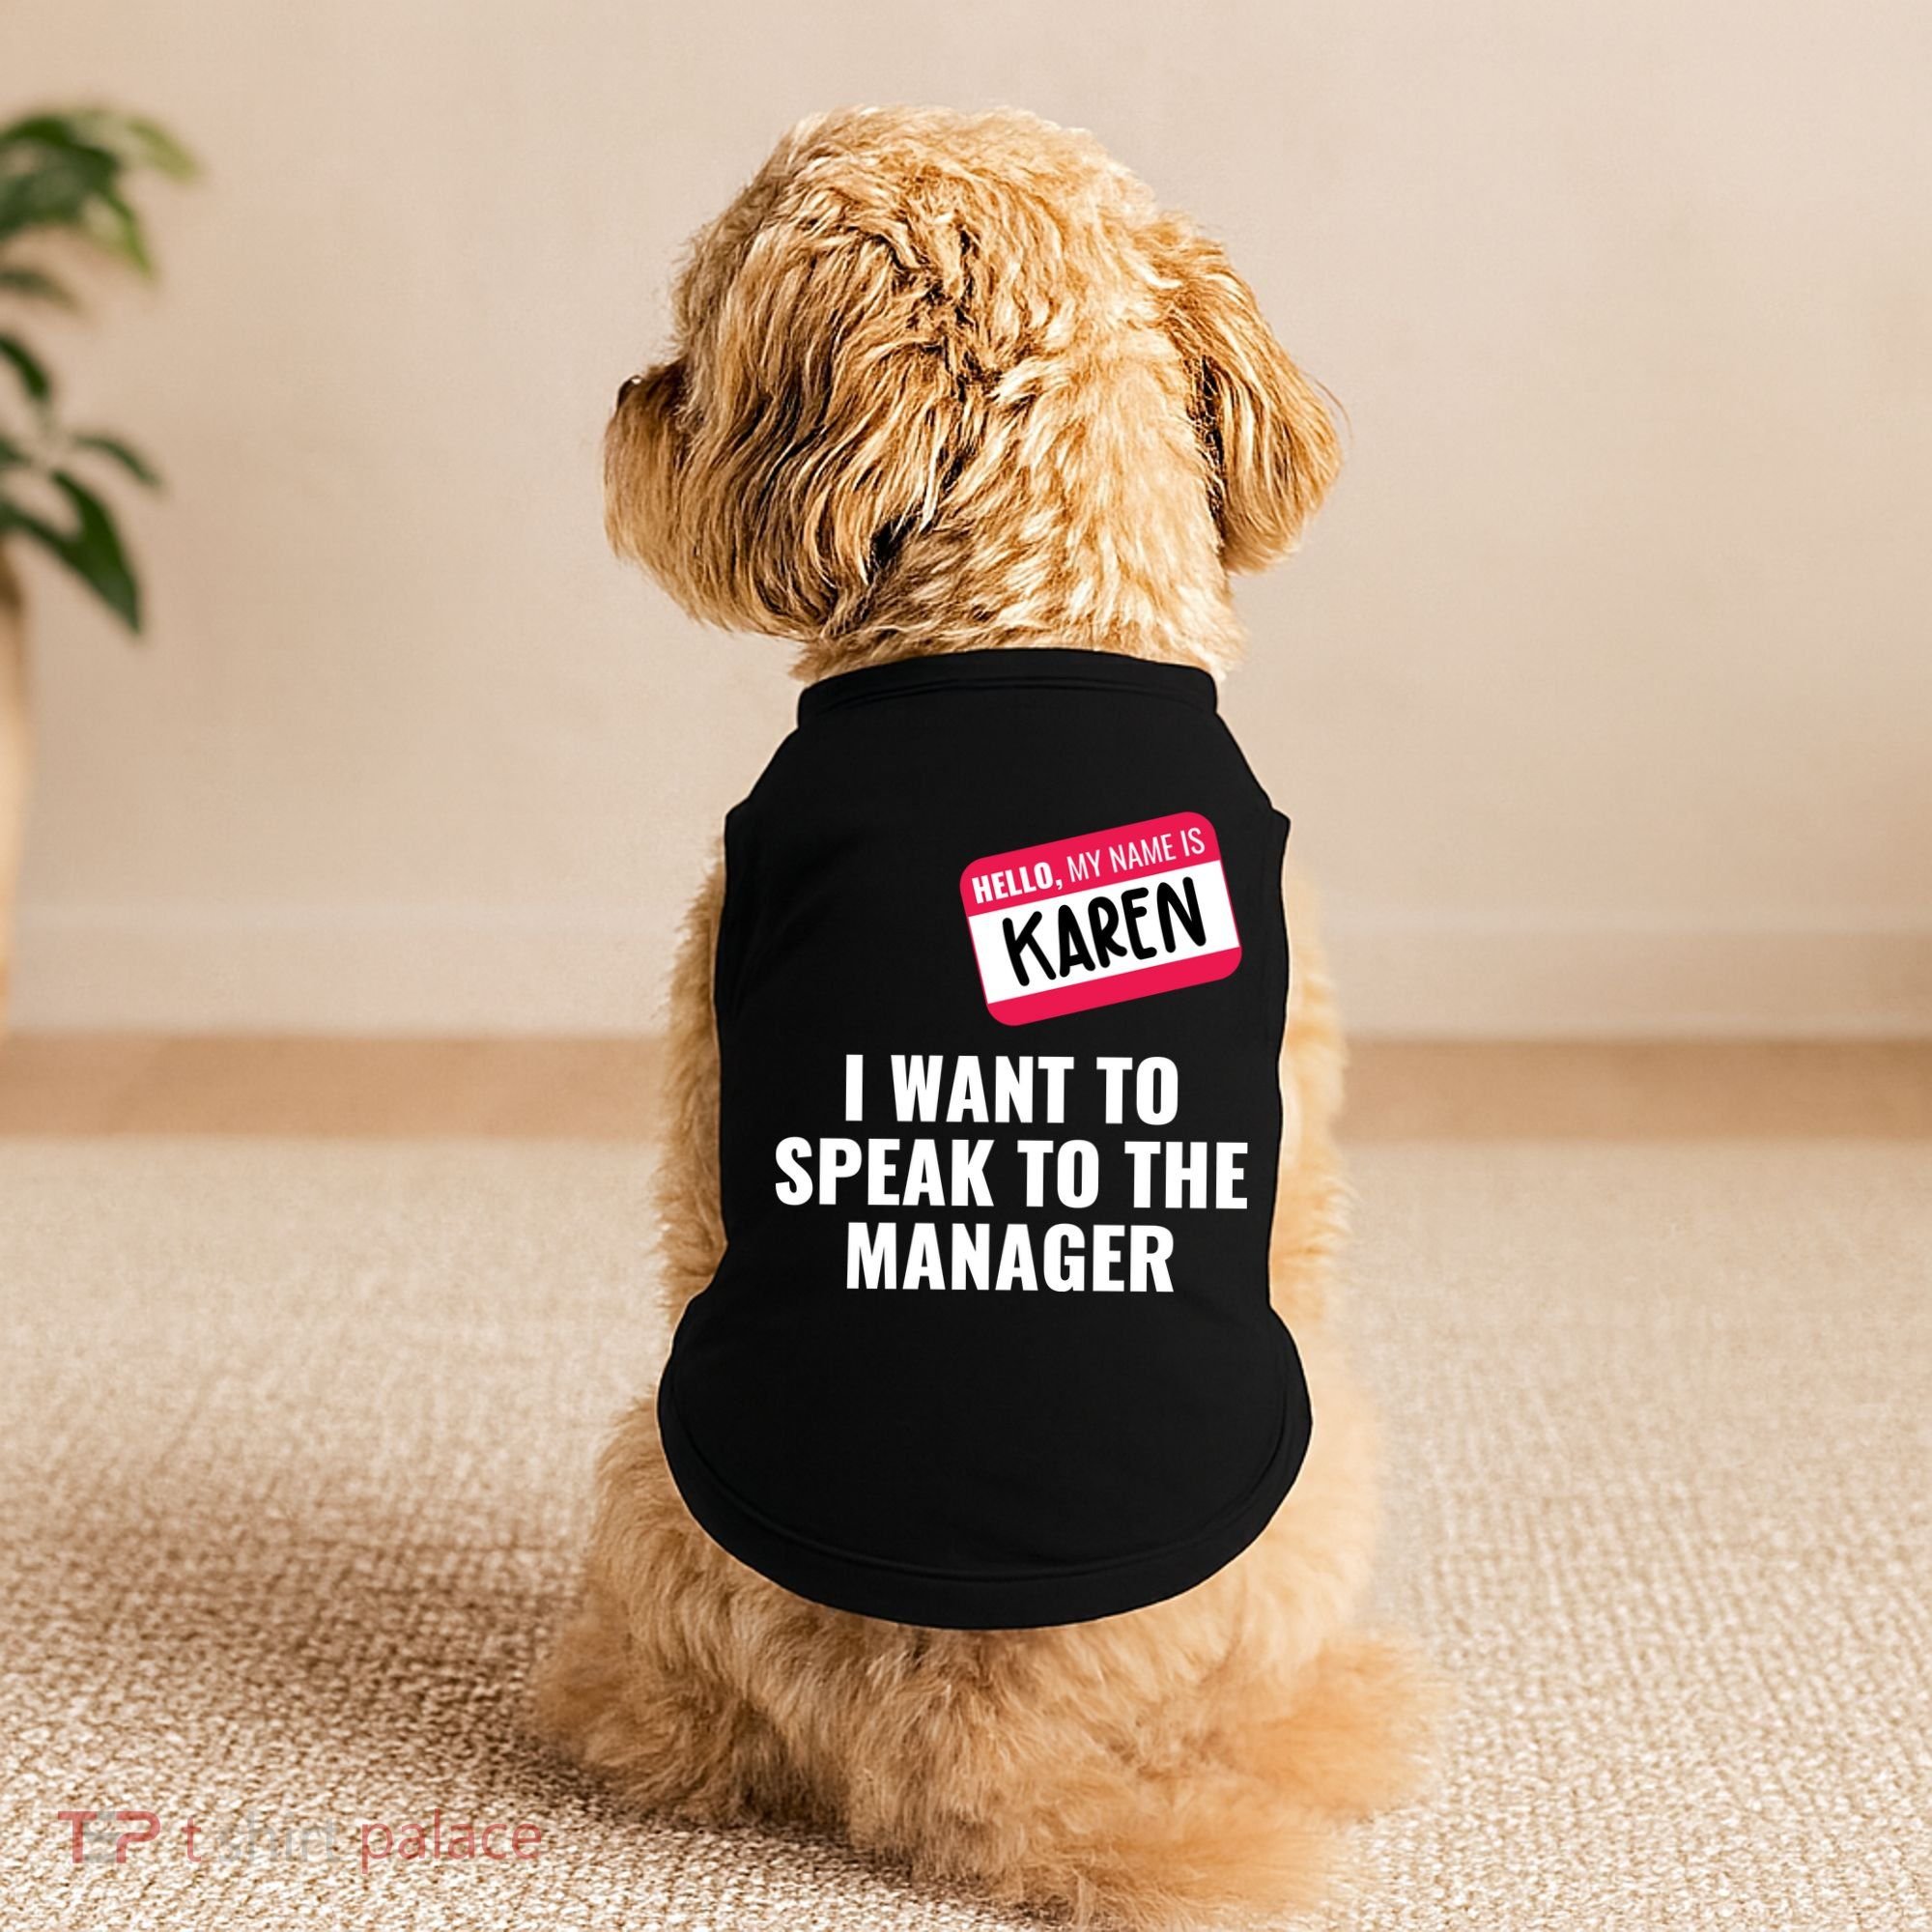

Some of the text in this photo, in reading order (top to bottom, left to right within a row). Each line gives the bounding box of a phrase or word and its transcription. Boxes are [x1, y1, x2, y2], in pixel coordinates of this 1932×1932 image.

[972, 827, 1206, 904] HELLO, MY NAME IS
[1002, 876, 1207, 986] KAREN
[846, 1054, 1178, 1125] I WANT TO
[776, 1137, 1248, 1208] SPEAK TO THE
[847, 1222, 1174, 1292] MANAGER
